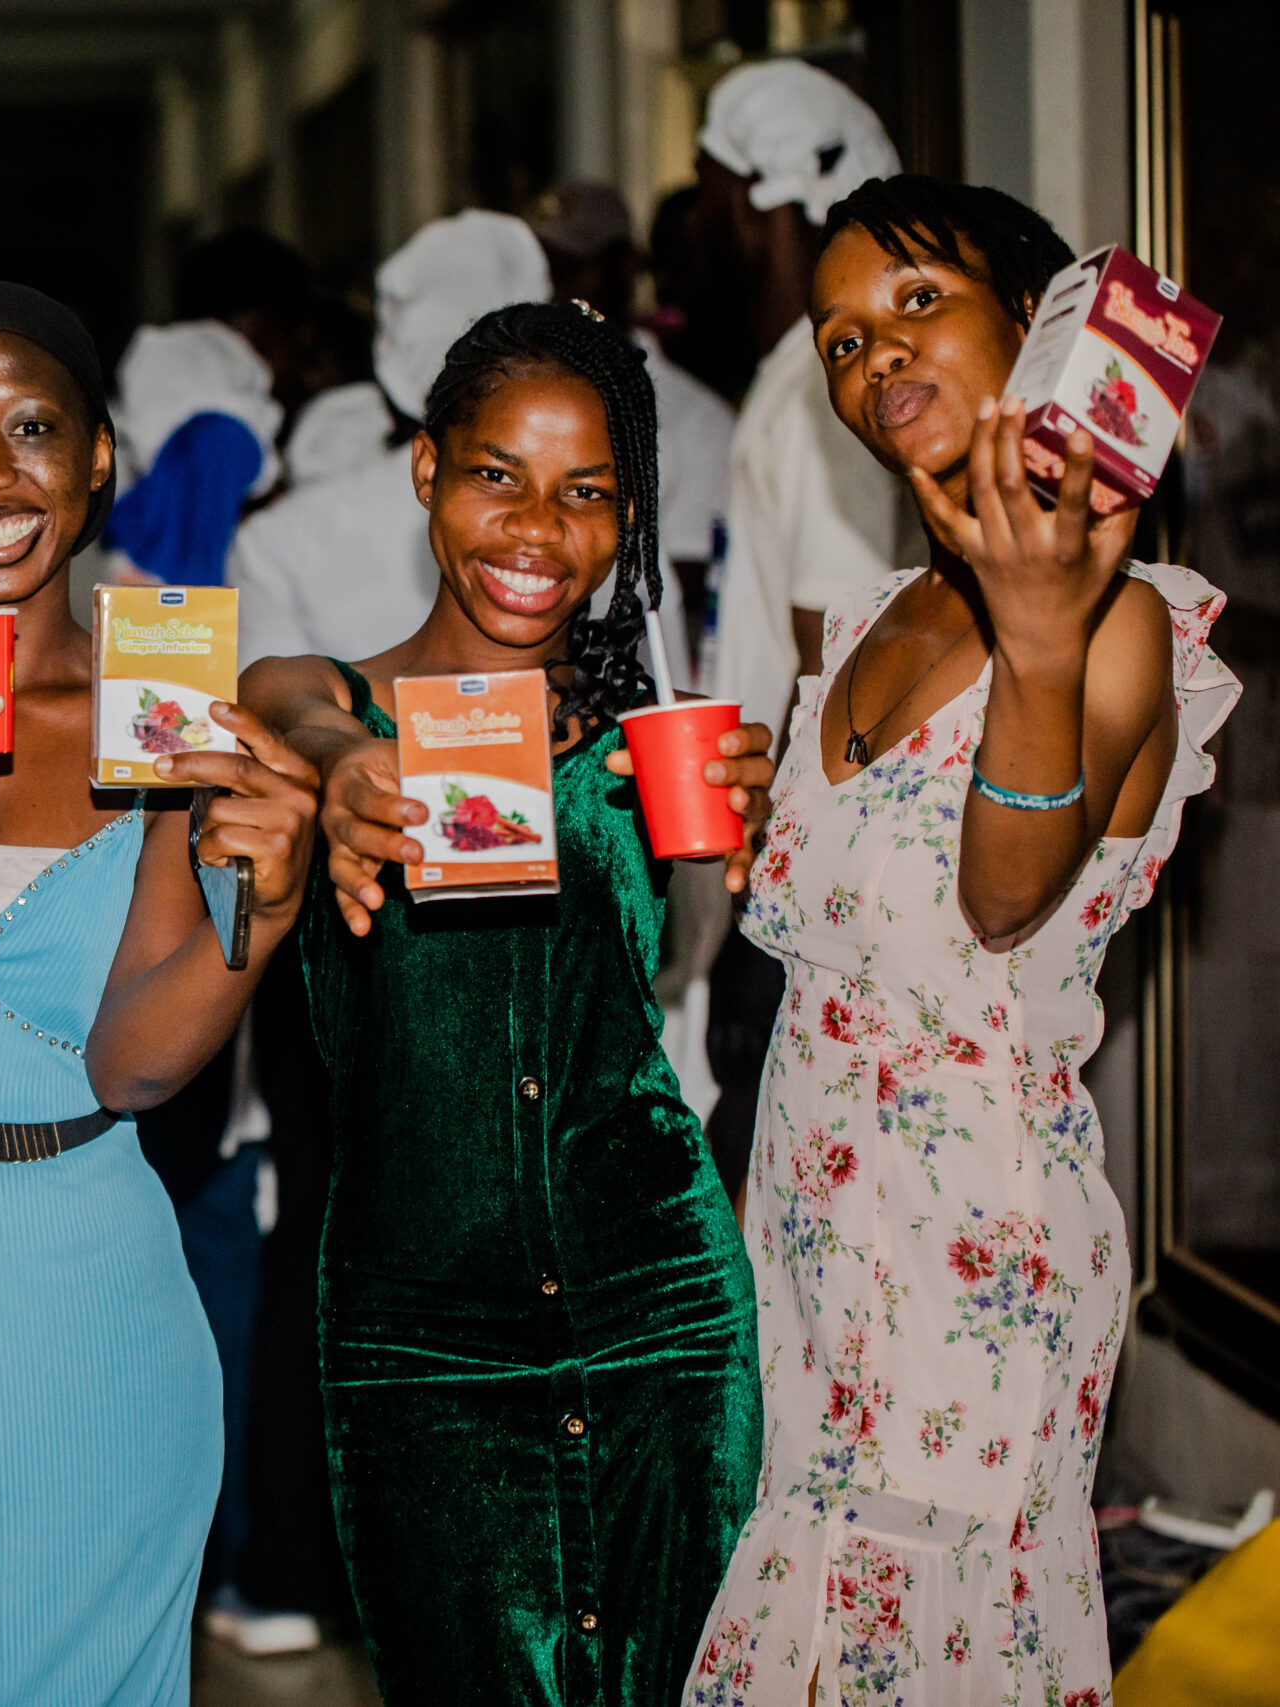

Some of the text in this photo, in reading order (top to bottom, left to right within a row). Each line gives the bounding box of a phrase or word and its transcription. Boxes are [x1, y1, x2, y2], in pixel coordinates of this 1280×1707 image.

[112, 617, 165, 642] Nimah
[116, 640, 211, 655] Ginger Infusion
